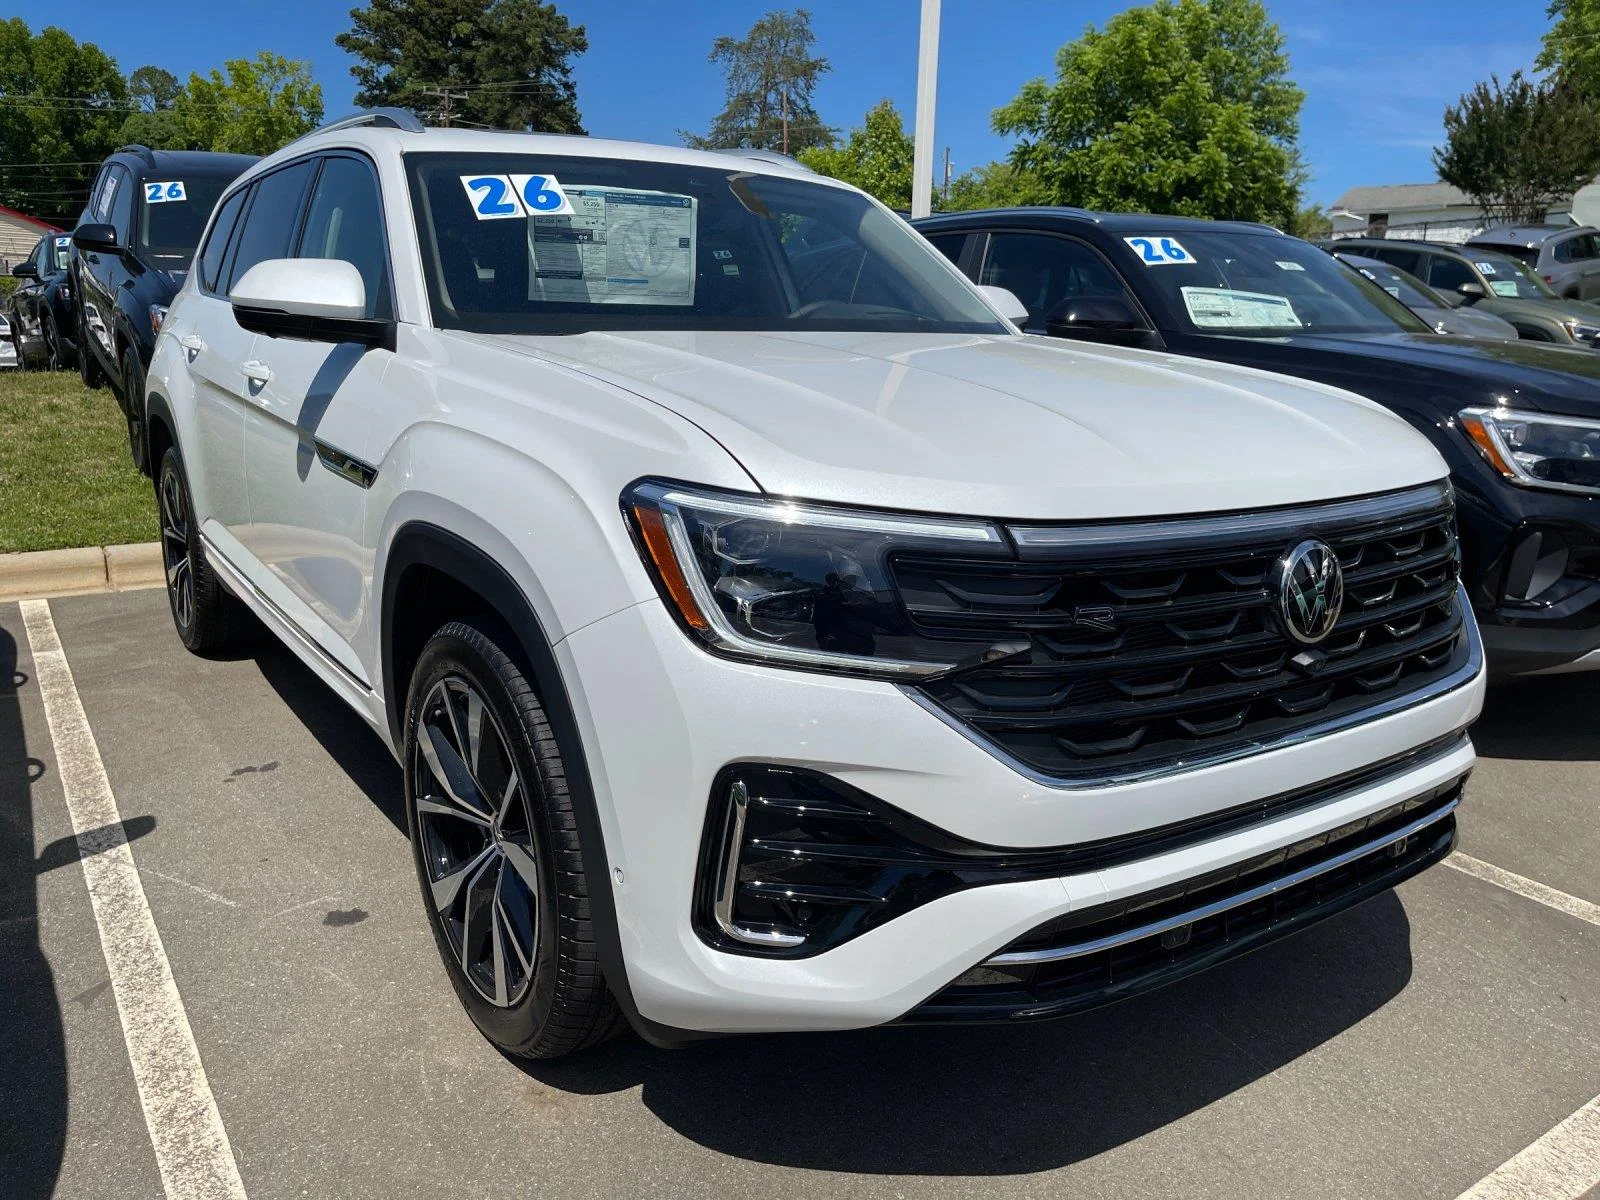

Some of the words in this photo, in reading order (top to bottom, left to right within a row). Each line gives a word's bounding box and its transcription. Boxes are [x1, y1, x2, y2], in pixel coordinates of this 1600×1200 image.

[147, 183, 183, 201] 26
[468, 175, 562, 215] 26
[1130, 238, 1186, 262] 26
